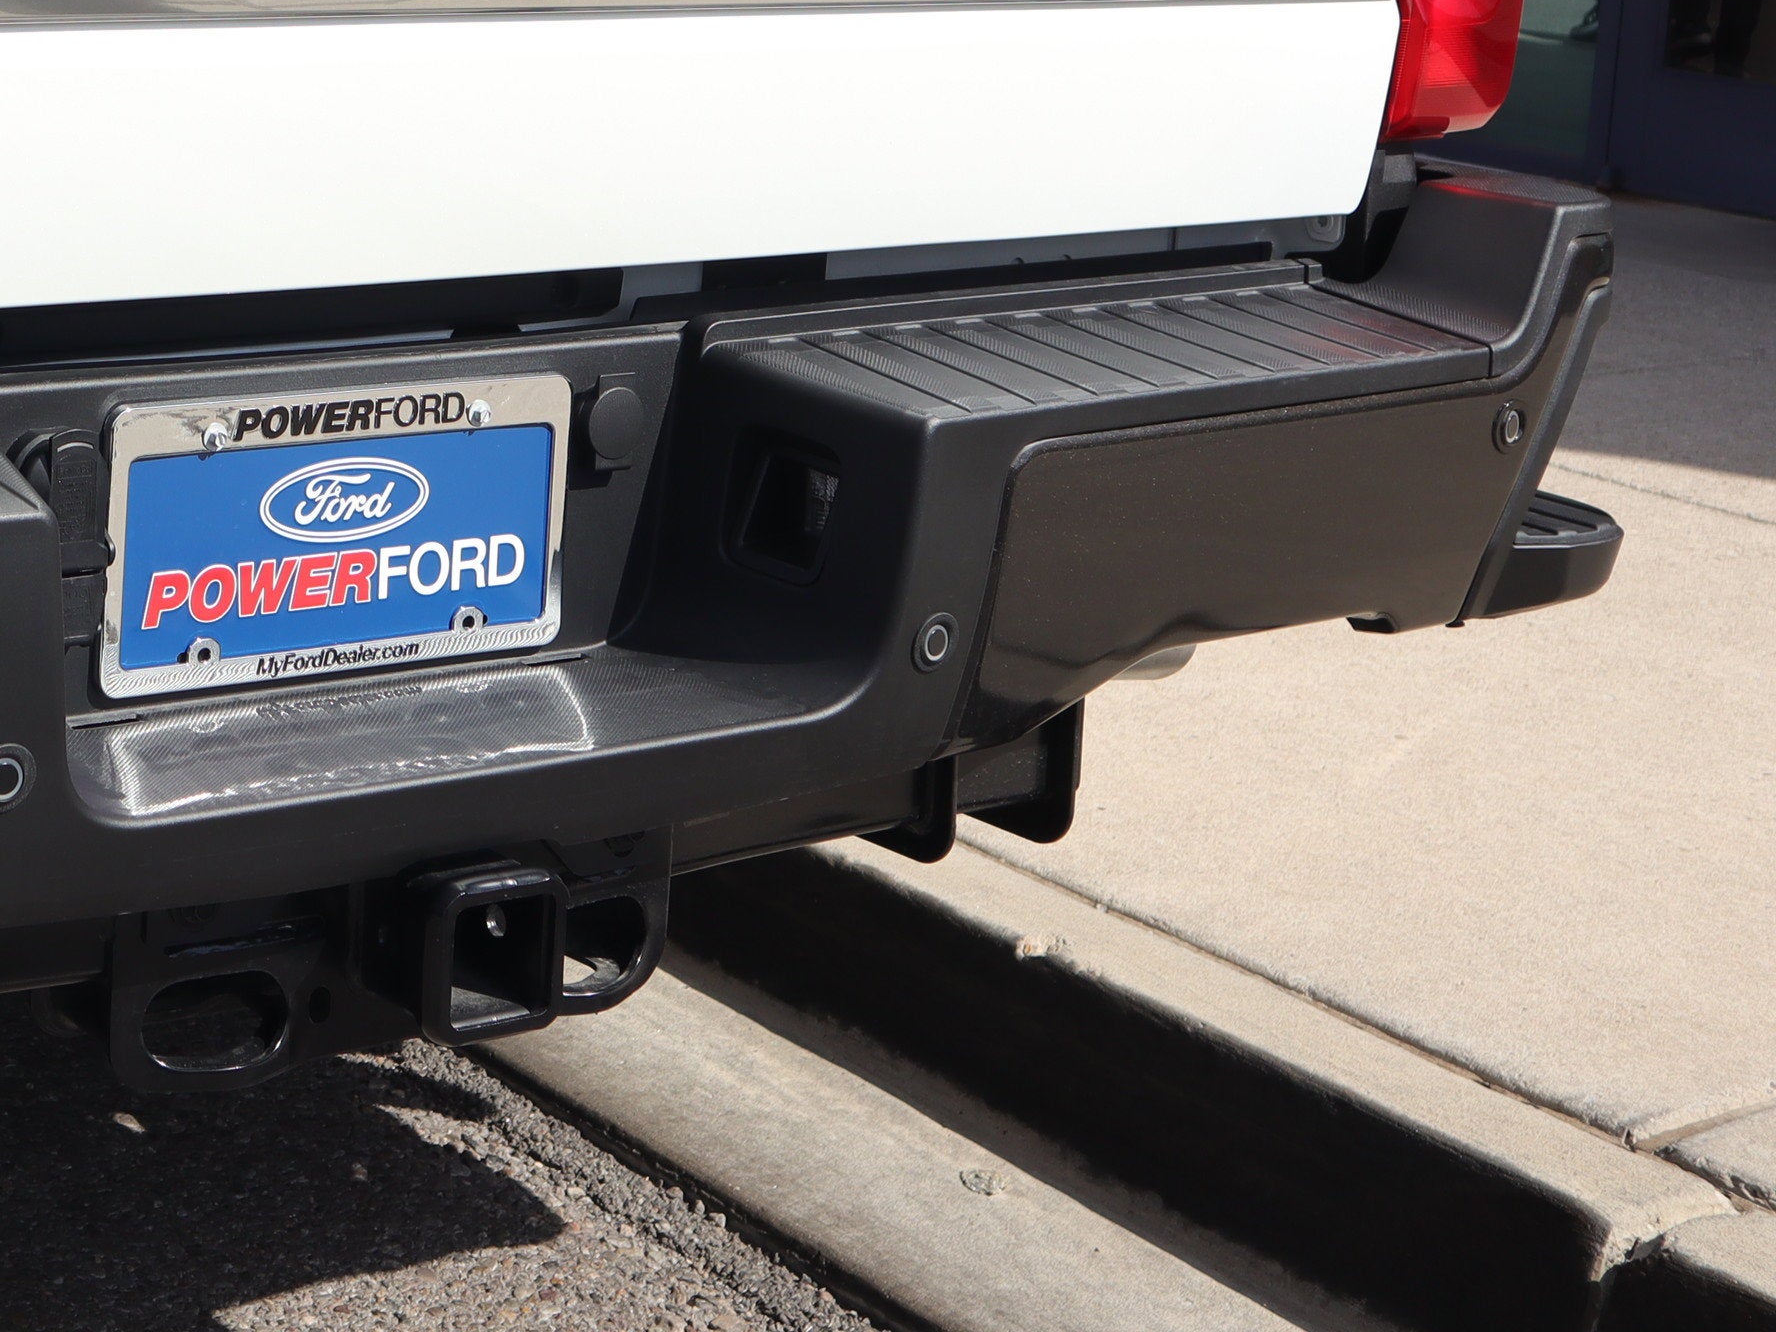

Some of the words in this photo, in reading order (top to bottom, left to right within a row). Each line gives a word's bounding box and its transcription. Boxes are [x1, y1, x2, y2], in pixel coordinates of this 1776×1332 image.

[293, 472, 394, 526] Ford
[140, 533, 527, 630] POWERFORD
[254, 641, 421, 677] MyFordDealer.com
